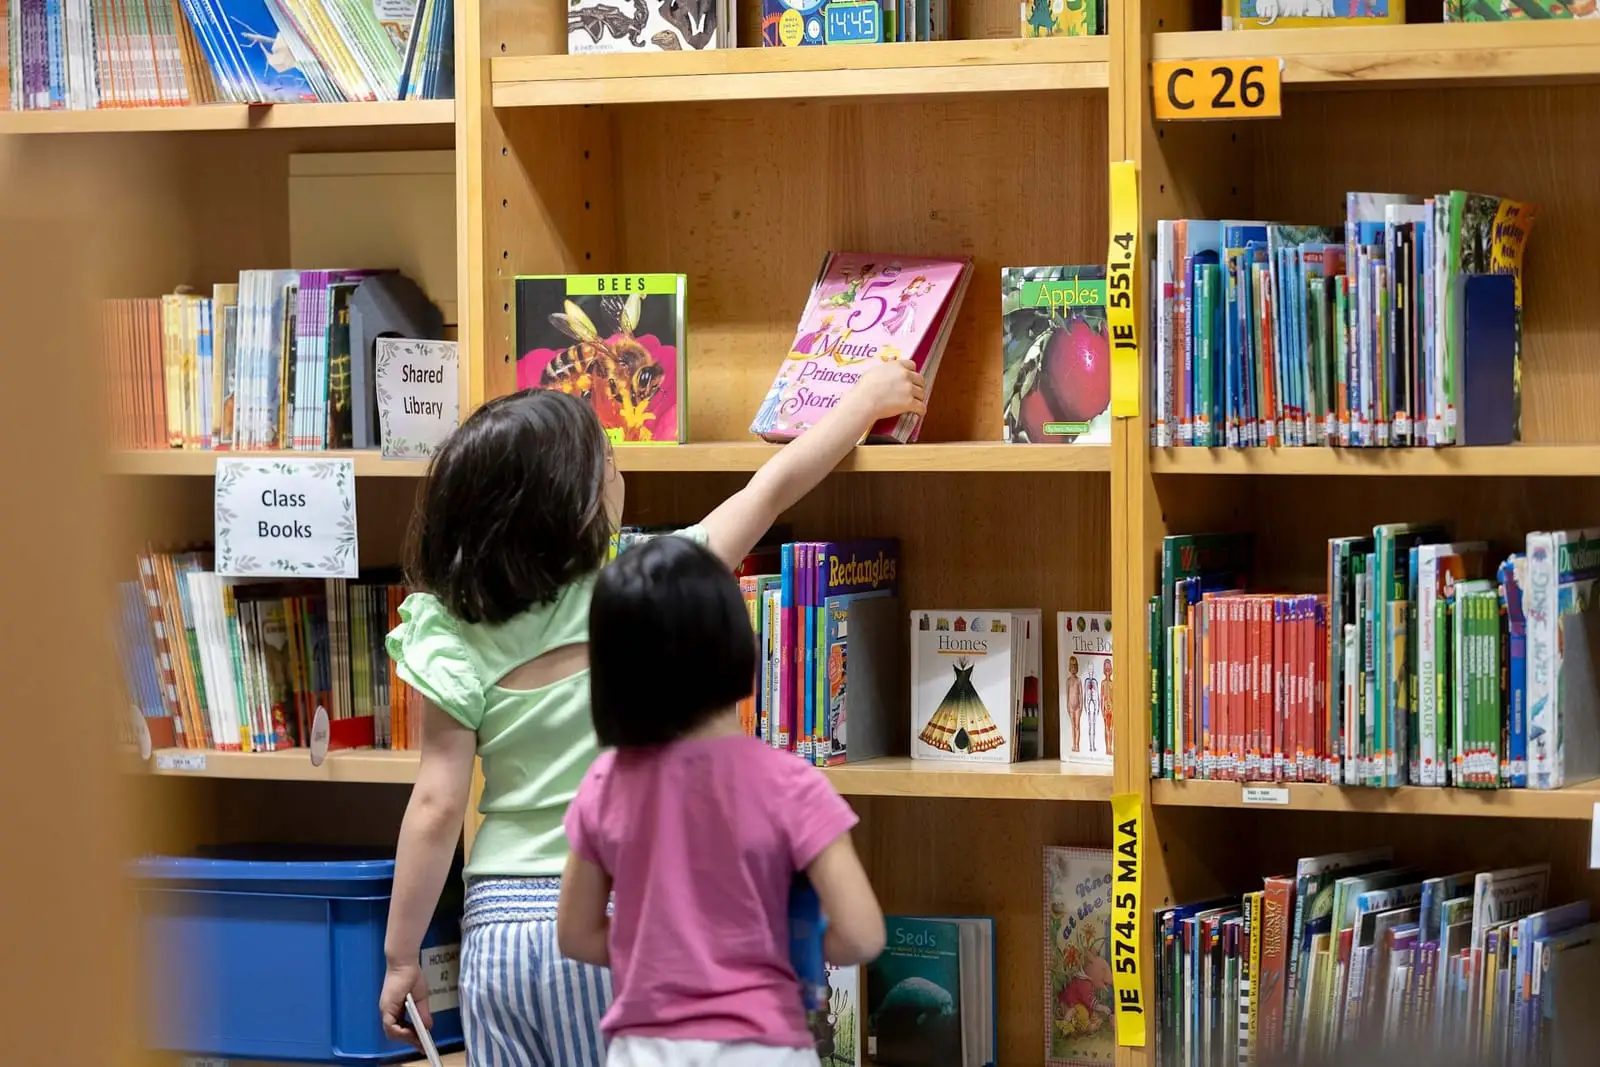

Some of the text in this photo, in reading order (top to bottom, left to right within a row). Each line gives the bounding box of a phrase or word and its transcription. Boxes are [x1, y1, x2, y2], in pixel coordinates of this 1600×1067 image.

[830, 9, 874, 35] 14:45
[1167, 65, 1265, 110] C 26
[597, 277, 645, 291] BEES
[1036, 274, 1099, 319] Apples
[1109, 231, 1138, 350] JE 551.4
[846, 279, 896, 333] 5
[815, 334, 878, 358] Minute
[402, 364, 444, 384] Shared
[403, 396, 443, 419] Library
[780, 387, 841, 415] Stori
[261, 488, 306, 507] Class
[258, 520, 312, 538] Books
[829, 551, 896, 588] Rectangles
[938, 635, 988, 651] Homes
[1072, 635, 1113, 651] The Bo
[1422, 661, 1434, 739] DINOSAURS
[1075, 873, 1112, 898] Kno
[1116, 818, 1143, 1014] JE 574.5 MAA
[895, 927, 936, 947] Seals
